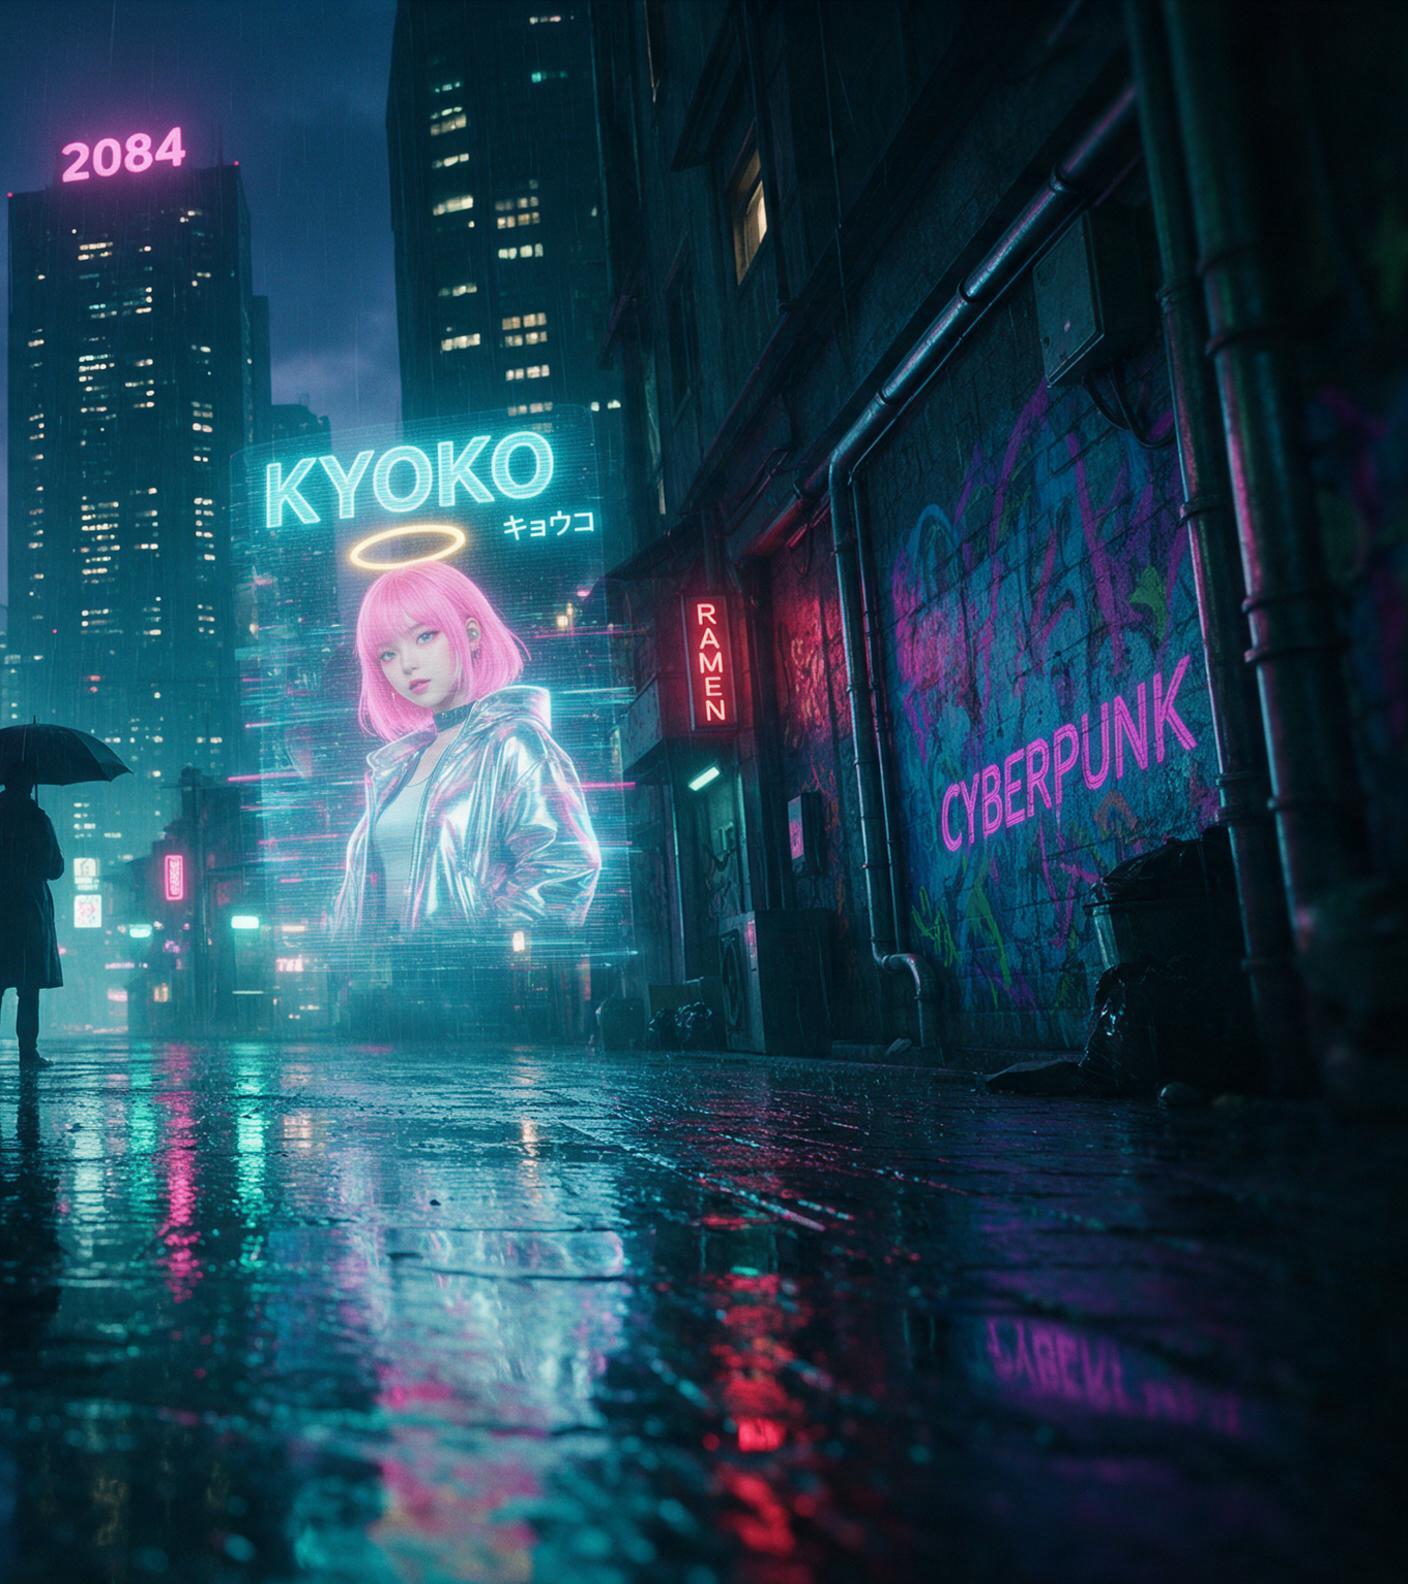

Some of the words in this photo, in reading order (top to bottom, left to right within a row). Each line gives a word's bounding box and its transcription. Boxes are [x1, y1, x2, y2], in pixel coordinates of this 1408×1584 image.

[61, 127, 186, 183] 2084
[266, 431, 554, 528] KYOKO
[503, 510, 594, 541] キョウコ
[696, 603, 726, 721] RAMEN
[941, 654, 1198, 852] CYBERPUNK
